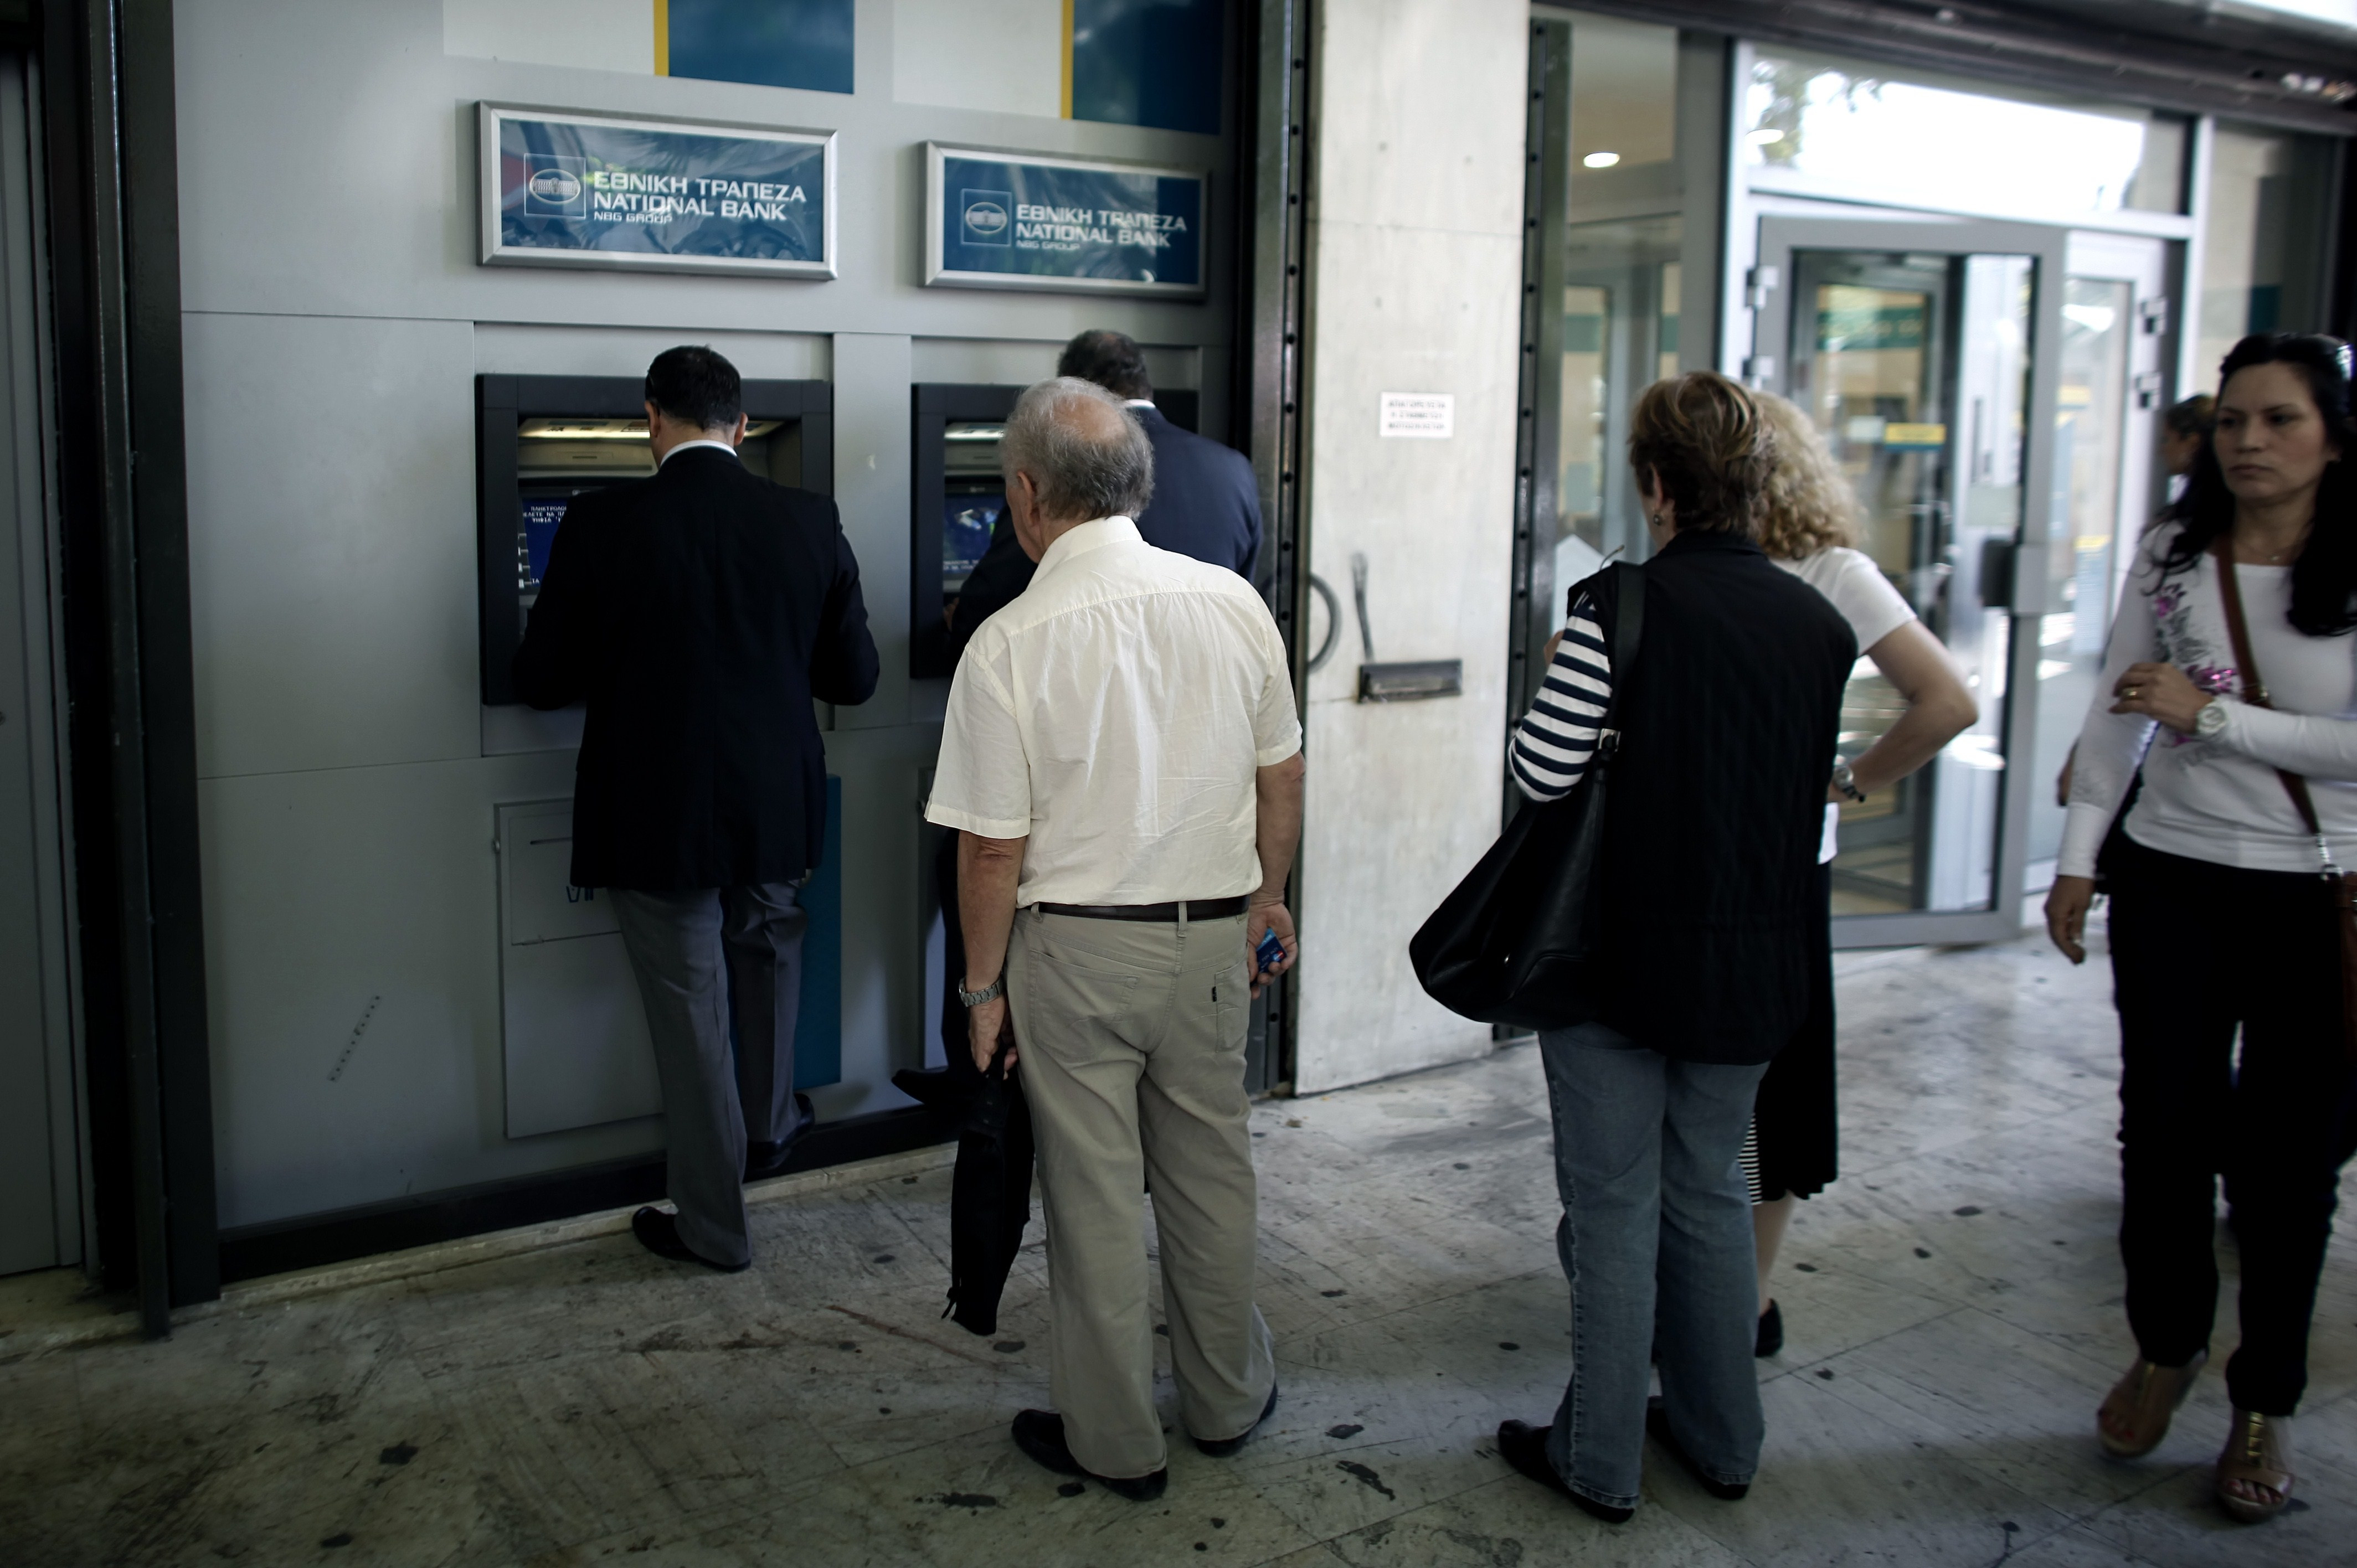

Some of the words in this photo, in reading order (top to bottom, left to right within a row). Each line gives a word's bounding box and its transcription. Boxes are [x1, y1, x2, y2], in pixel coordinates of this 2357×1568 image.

[594, 171, 687, 194] ΕΘΝΙΚΗ
[696, 178, 807, 203] ΤΡΑΠΕΖΑ
[594, 192, 714, 216] NATIONAL
[722, 199, 786, 220] BANK
[594, 210, 622, 221] NBG
[626, 212, 673, 224] GROUP
[1017, 204, 1092, 224] ΕΘΝΙΚΗ
[1098, 210, 1187, 231] ΤΡΑΠΕΖΑ
[1016, 223, 1112, 244] NATIONAL
[1119, 228, 1171, 248] BANK
[1016, 239, 1039, 249] NBG
